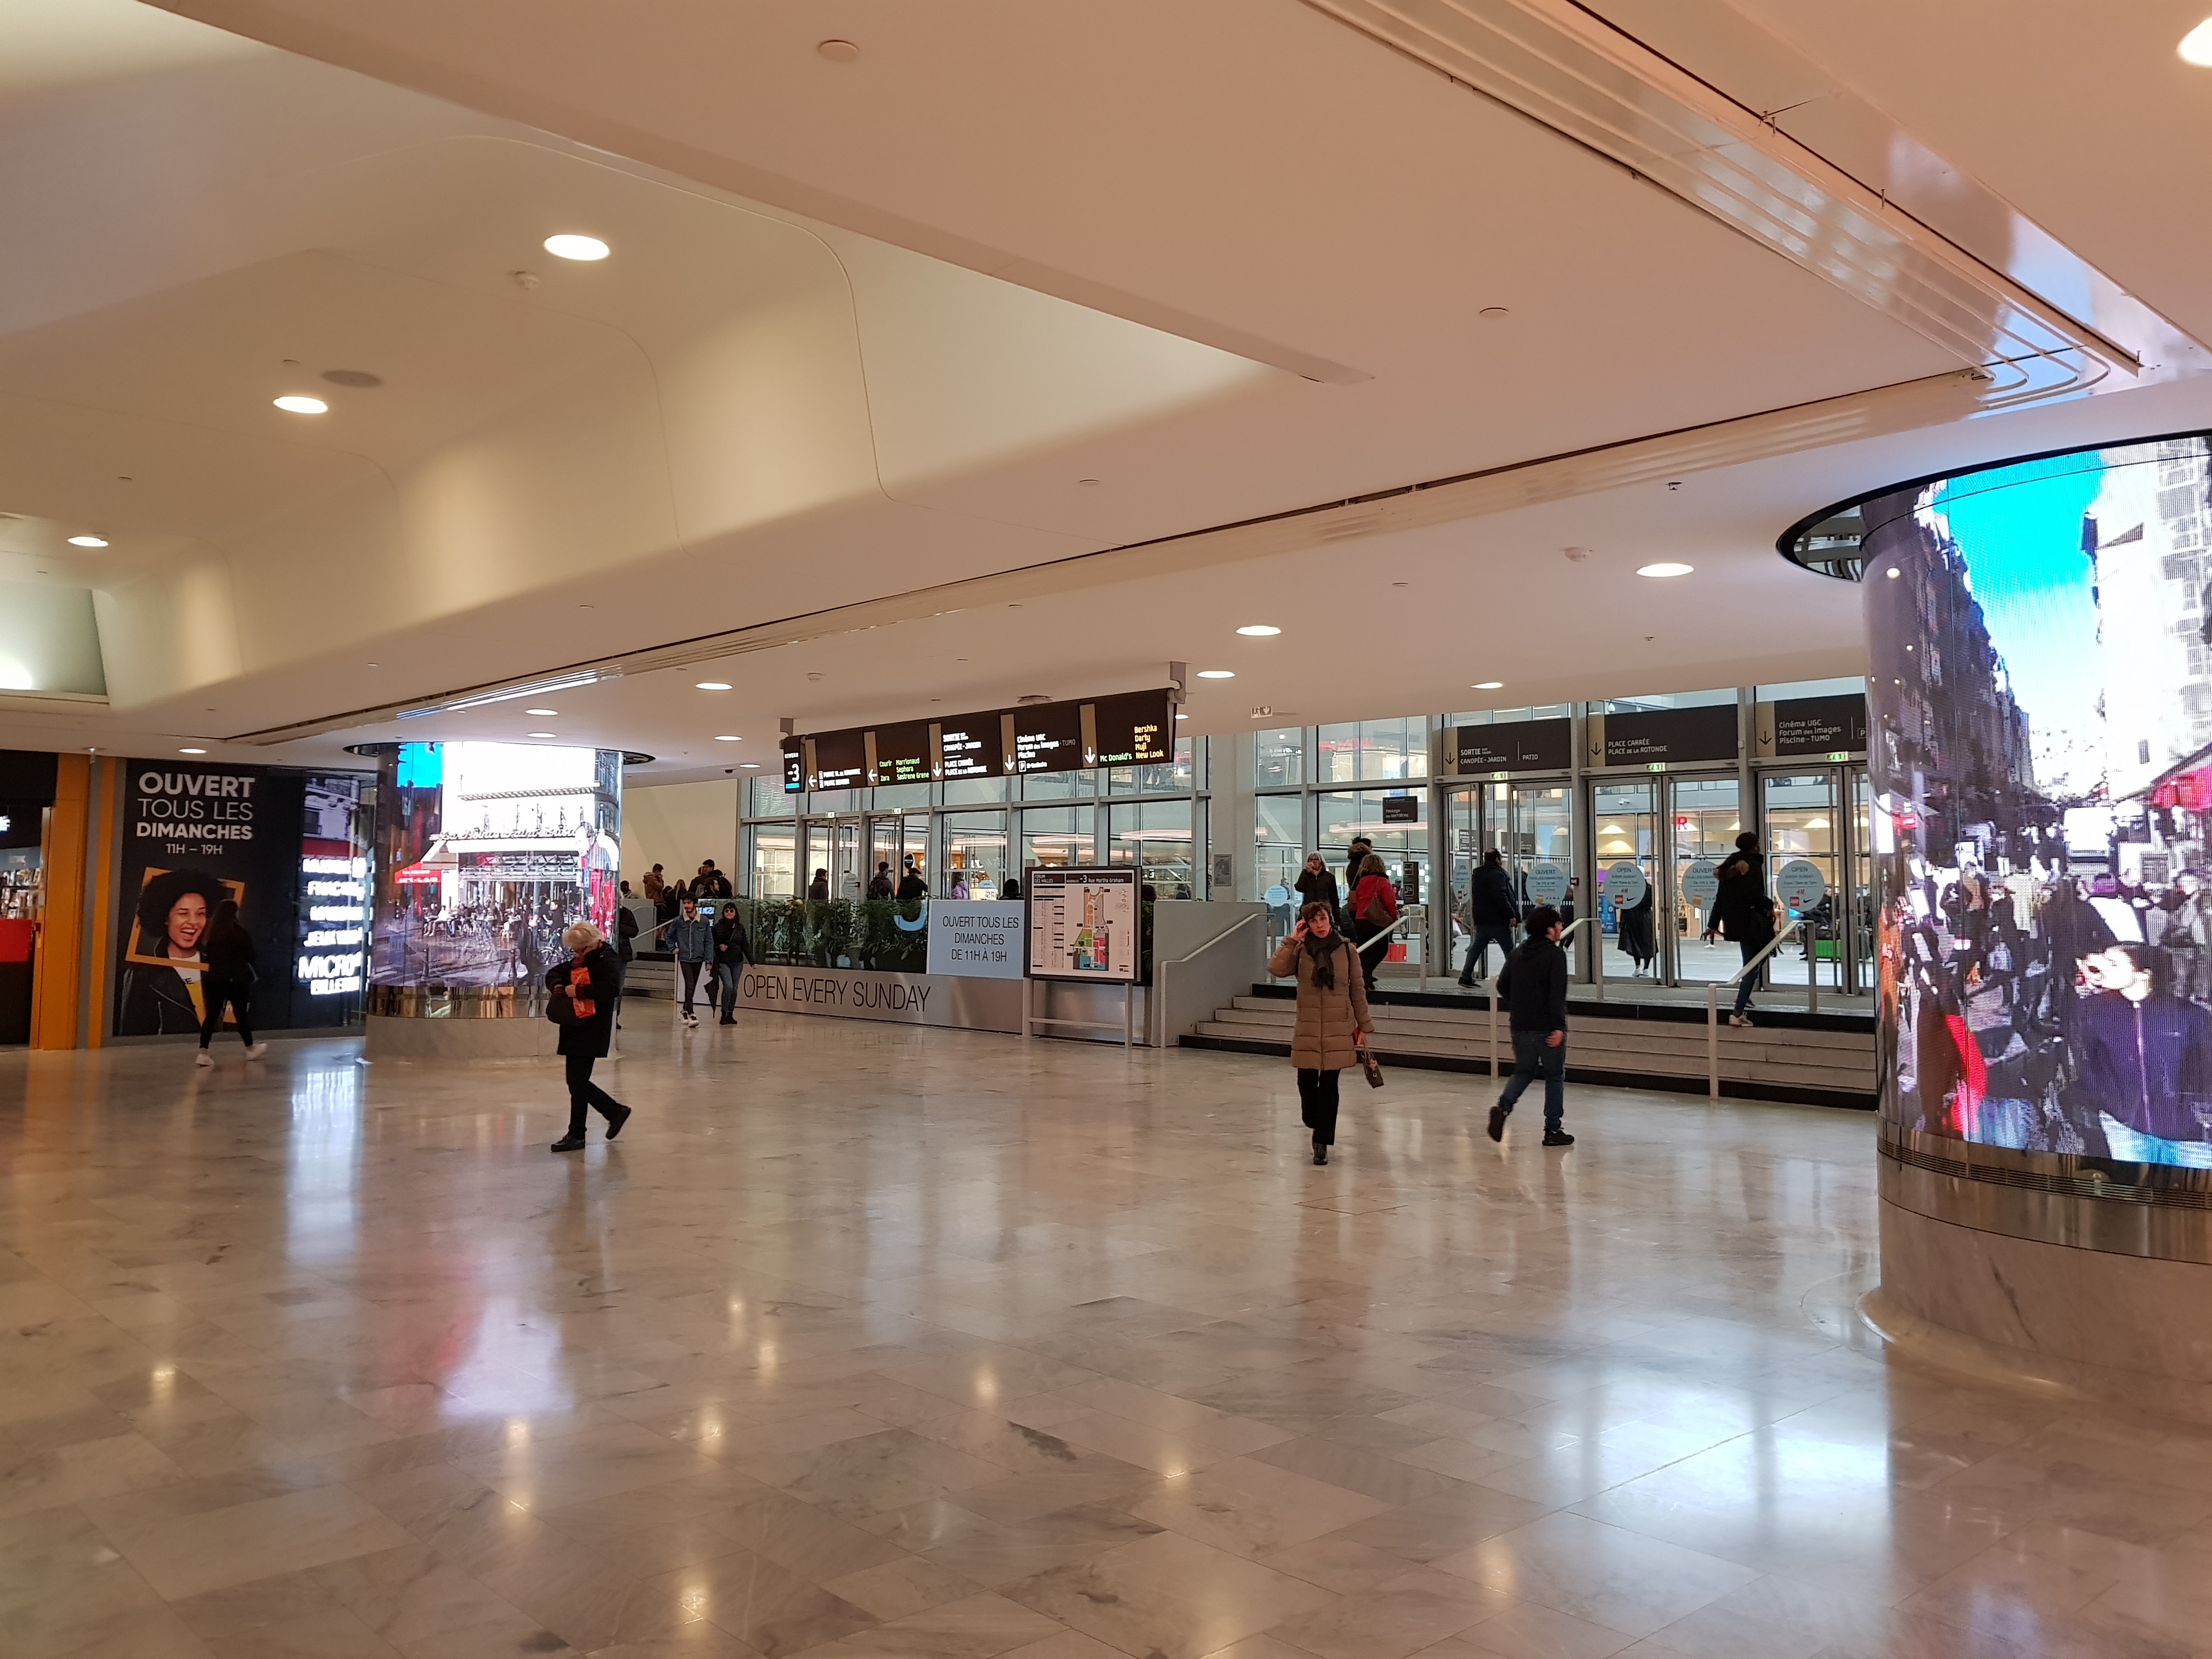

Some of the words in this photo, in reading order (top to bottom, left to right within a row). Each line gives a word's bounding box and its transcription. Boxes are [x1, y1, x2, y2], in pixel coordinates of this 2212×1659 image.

[1134, 724, 1158, 733] Bershka
[1779, 720, 1805, 729] Cinéma
[1814, 726, 1842, 735] Images
[1135, 733, 1151, 743] Darty
[1627, 738, 1650, 746] CARRÉE
[1135, 742, 1147, 752] Muji
[1109, 752, 1132, 761] Donald's
[1150, 749, 1164, 758] Look
[139, 771, 256, 798] OUVERT
[137, 798, 205, 819] TOUS
[213, 801, 253, 821] LES
[137, 822, 253, 840] DIMANCHES
[165, 843, 185, 854] 11H
[201, 844, 223, 855] 19H
[943, 916, 975, 927] OUVERT
[977, 916, 1000, 928] TOUS
[1002, 917, 1019, 928] LES
[955, 933, 1005, 945] DIMANCHES
[951, 949, 962, 960] DE
[965, 950, 980, 961] 11H
[982, 947, 989, 961] À
[990, 951, 1007, 962] 19H
[743, 974, 787, 1000] OPEN
[792, 977, 848, 1005] EVERY
[853, 981, 932, 1012] SUNDAY
